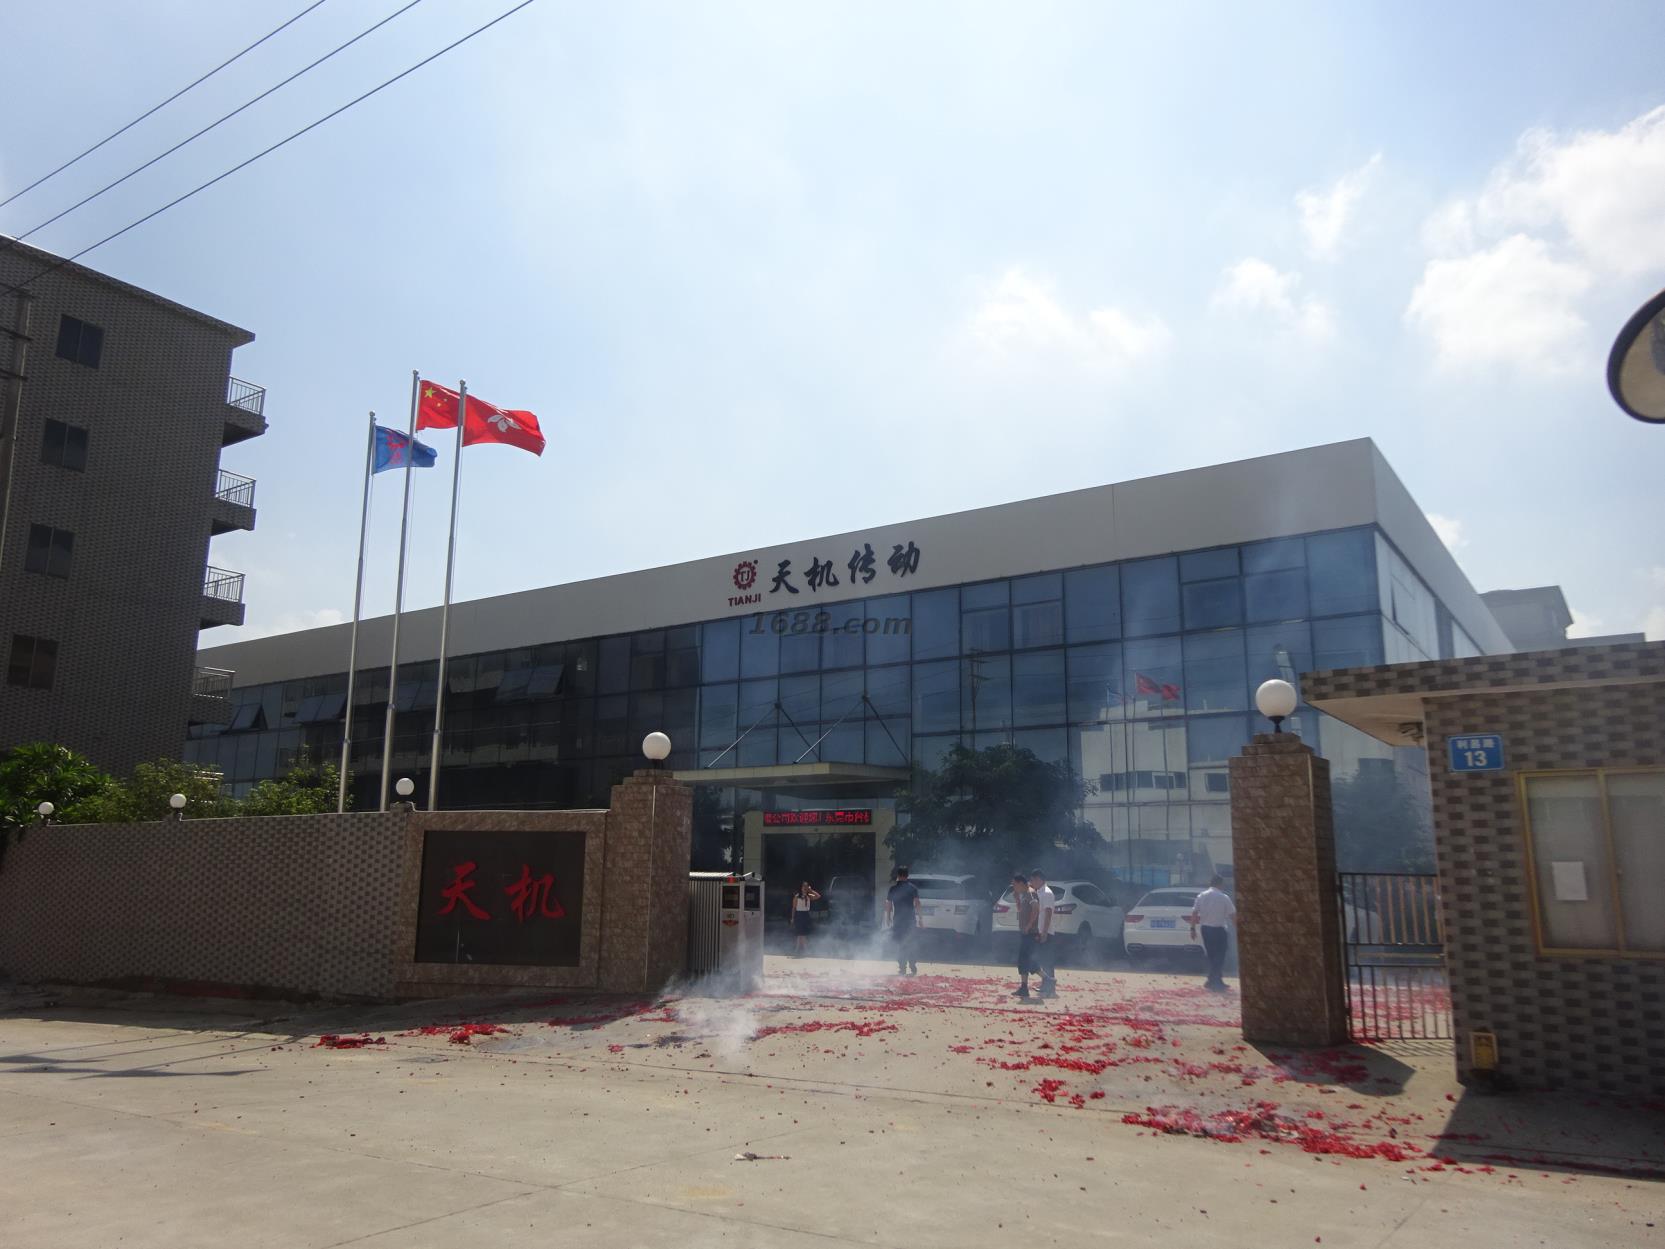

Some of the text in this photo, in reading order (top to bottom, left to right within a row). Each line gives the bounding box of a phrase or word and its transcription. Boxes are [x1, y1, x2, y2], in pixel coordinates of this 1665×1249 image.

[769, 541, 920, 593] 天机传动
[728, 593, 761, 607] TIANJI
[1464, 750, 1488, 767] 13
[436, 861, 567, 923] 天机
